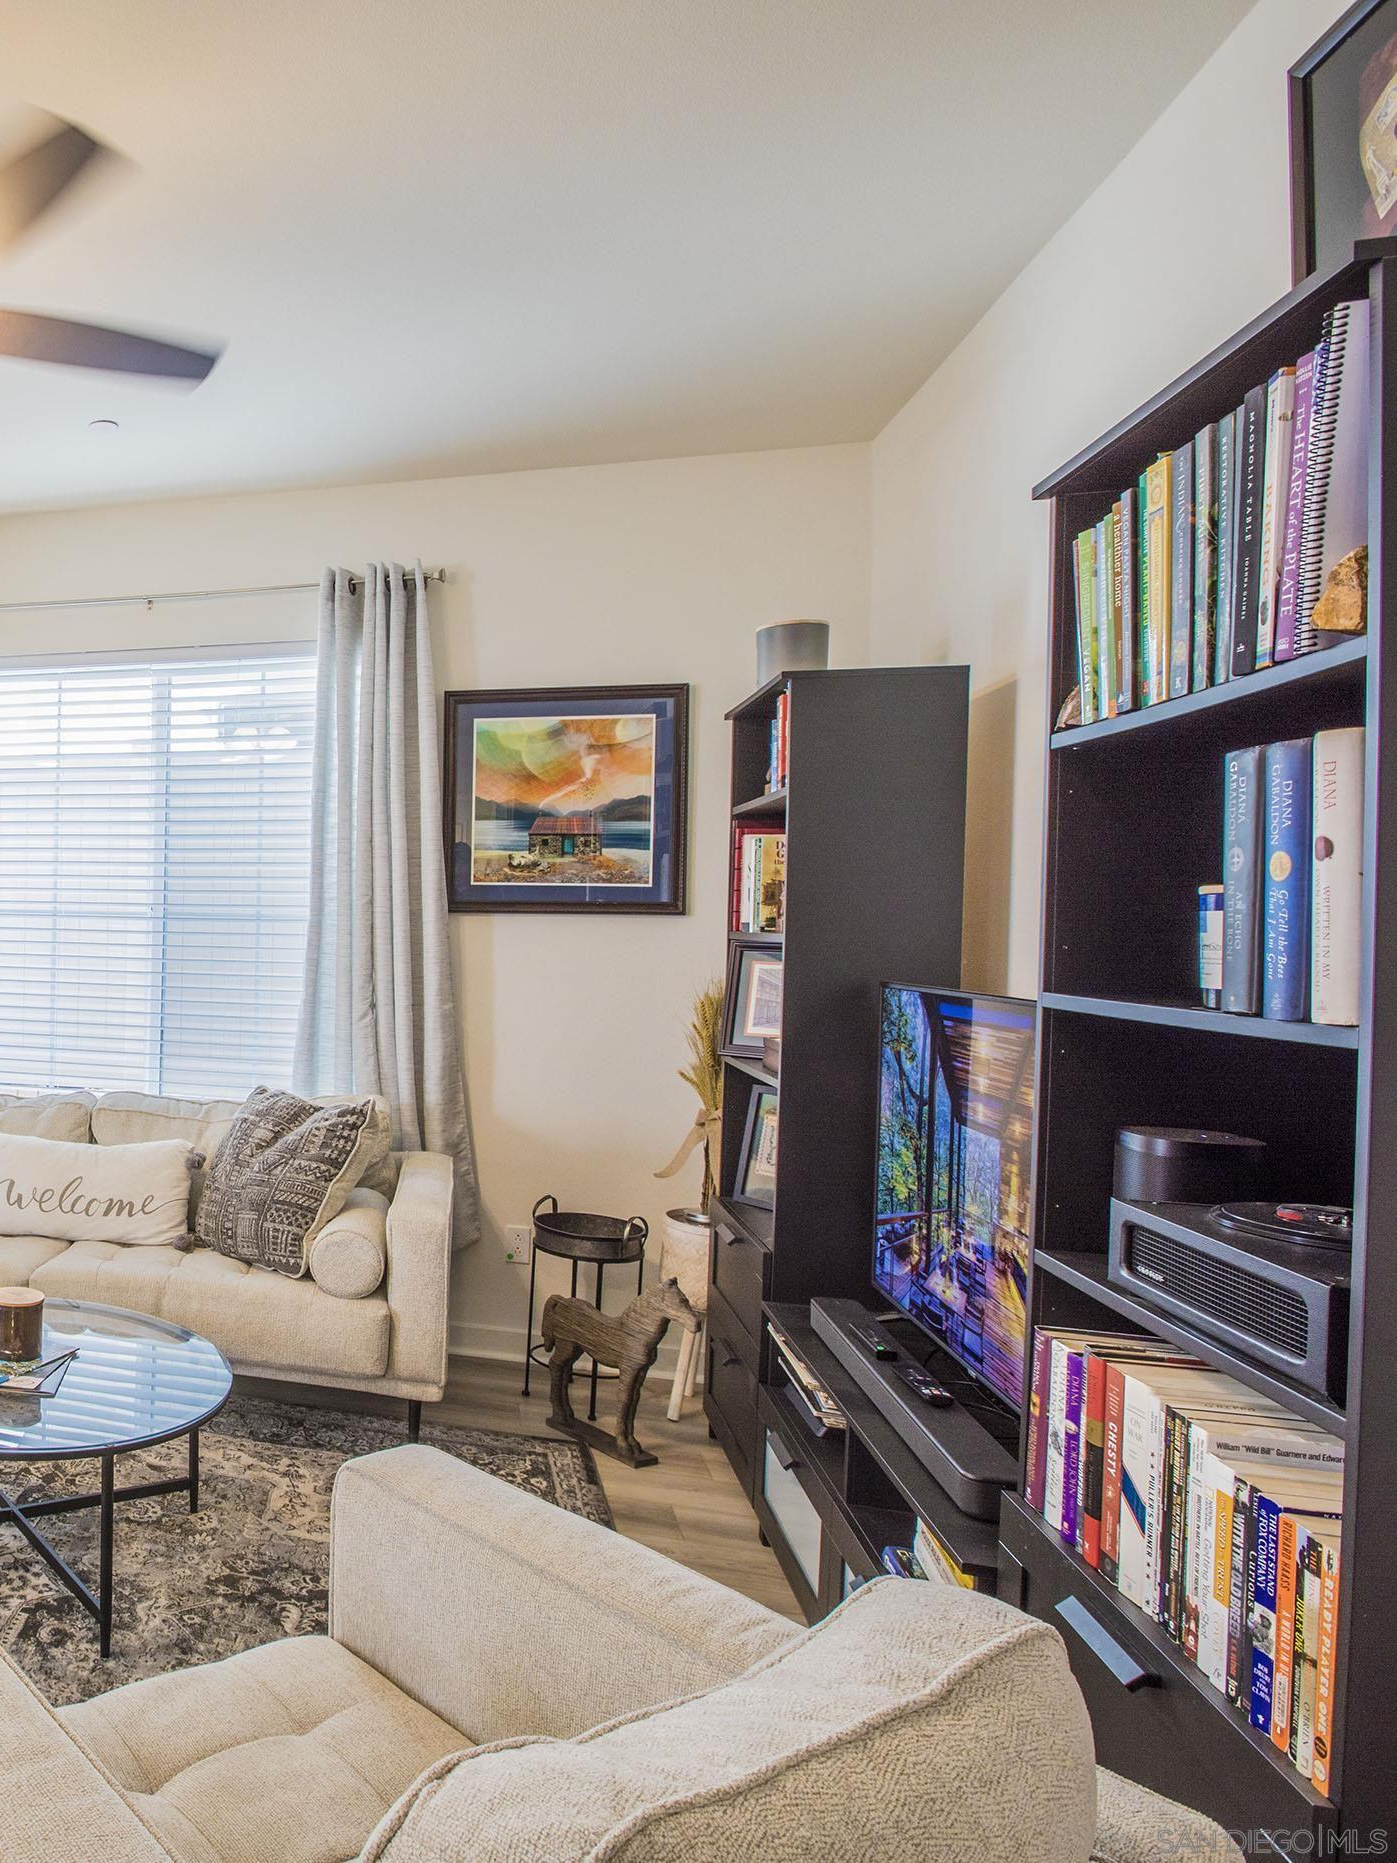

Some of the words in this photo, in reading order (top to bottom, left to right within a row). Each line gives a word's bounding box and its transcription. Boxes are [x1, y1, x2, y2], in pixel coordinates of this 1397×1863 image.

[1296, 403, 1306, 430] The
[1247, 411, 1256, 490] MAGNOLIA
[1289, 431, 1306, 508] HEART
[1176, 474, 1186, 533] INDIAN
[1244, 496, 1253, 542] TABLE
[1289, 512, 1299, 526] of
[1122, 507, 1130, 547] VEGAN
[1286, 528, 1298, 549] the
[1114, 523, 1123, 573] healthier
[1122, 549, 1130, 582] PASTA
[1114, 575, 1123, 608] home
[1280, 551, 1297, 618] PLATE
[1122, 583, 1130, 619] NIGHT
[1238, 776, 1246, 824] DIANA
[1323, 760, 1337, 809] DIANA
[1229, 761, 1238, 841] GABALDON
[1270, 764, 1281, 845] GABALDON
[1282, 780, 1293, 828] DIANA
[1227, 881, 1234, 894] IN
[1234, 892, 1243, 908] AN
[1268, 887, 1277, 913] That
[1278, 889, 1289, 905] Go
[1278, 908, 1289, 932] Tell
[1322, 885, 1330, 940] WRITTEN
[1234, 913, 1242, 950] ECHO
[1267, 926, 1276, 948] Am
[1278, 936, 1289, 951] the
[1266, 953, 1276, 980] Gone
[1277, 953, 1288, 979] Bees
[1322, 944, 1330, 959] IN
[1322, 961, 1330, 980] MY
[1070, 1376, 1079, 1406] DIANA
[1130, 1418, 1140, 1429] ON
[1069, 1440, 1078, 1468] LORD
[1107, 1421, 1118, 1477] CHESTY
[1216, 1441, 1240, 1451] William
[1241, 1444, 1259, 1454] "Wild
[1276, 1449, 1307, 1460] Guarnere
[1308, 1452, 1321, 1462] and
[1068, 1469, 1078, 1497] JOHN
[1259, 1509, 1266, 1517] of
[1259, 1517, 1268, 1540] FOX
[1269, 1514, 1277, 1535] THE
[1219, 1511, 1227, 1551] SPEED
[1233, 1512, 1245, 1548] WITH
[1282, 1521, 1292, 1560] RICHARD
[1202, 1537, 1212, 1580] Getting
[1231, 1547, 1244, 1571] THE
[1268, 1534, 1276, 1561] LAST
[1217, 1560, 1225, 1599] TRUST
[1247, 1550, 1257, 1608] Curious
[1257, 1538, 1268, 1591] COMPANY
[1267, 1561, 1275, 1597] STAND
[1281, 1560, 1290, 1591] HAASS
[1202, 1583, 1211, 1610] Your
[1230, 1570, 1243, 1598] OLD
[1228, 1596, 1242, 1639] BREED
[1282, 1609, 1291, 1618] A
[1322, 1577, 1334, 1634] READY
[1201, 1611, 1209, 1640] Shot
[1281, 1619, 1291, 1650] WORLD
[1281, 1650, 1290, 1663] IN
[1294, 1630, 1304, 1654] ONE
[1257, 1663, 1268, 1674] BOB
[1319, 1635, 1331, 1698] PLAYER
[1256, 1681, 1268, 1694] TOM
[1292, 1696, 1300, 1728] CAMPBELL
[1302, 1702, 1311, 1746] O'BRIEN
[1317, 1700, 1327, 1735] ONE
